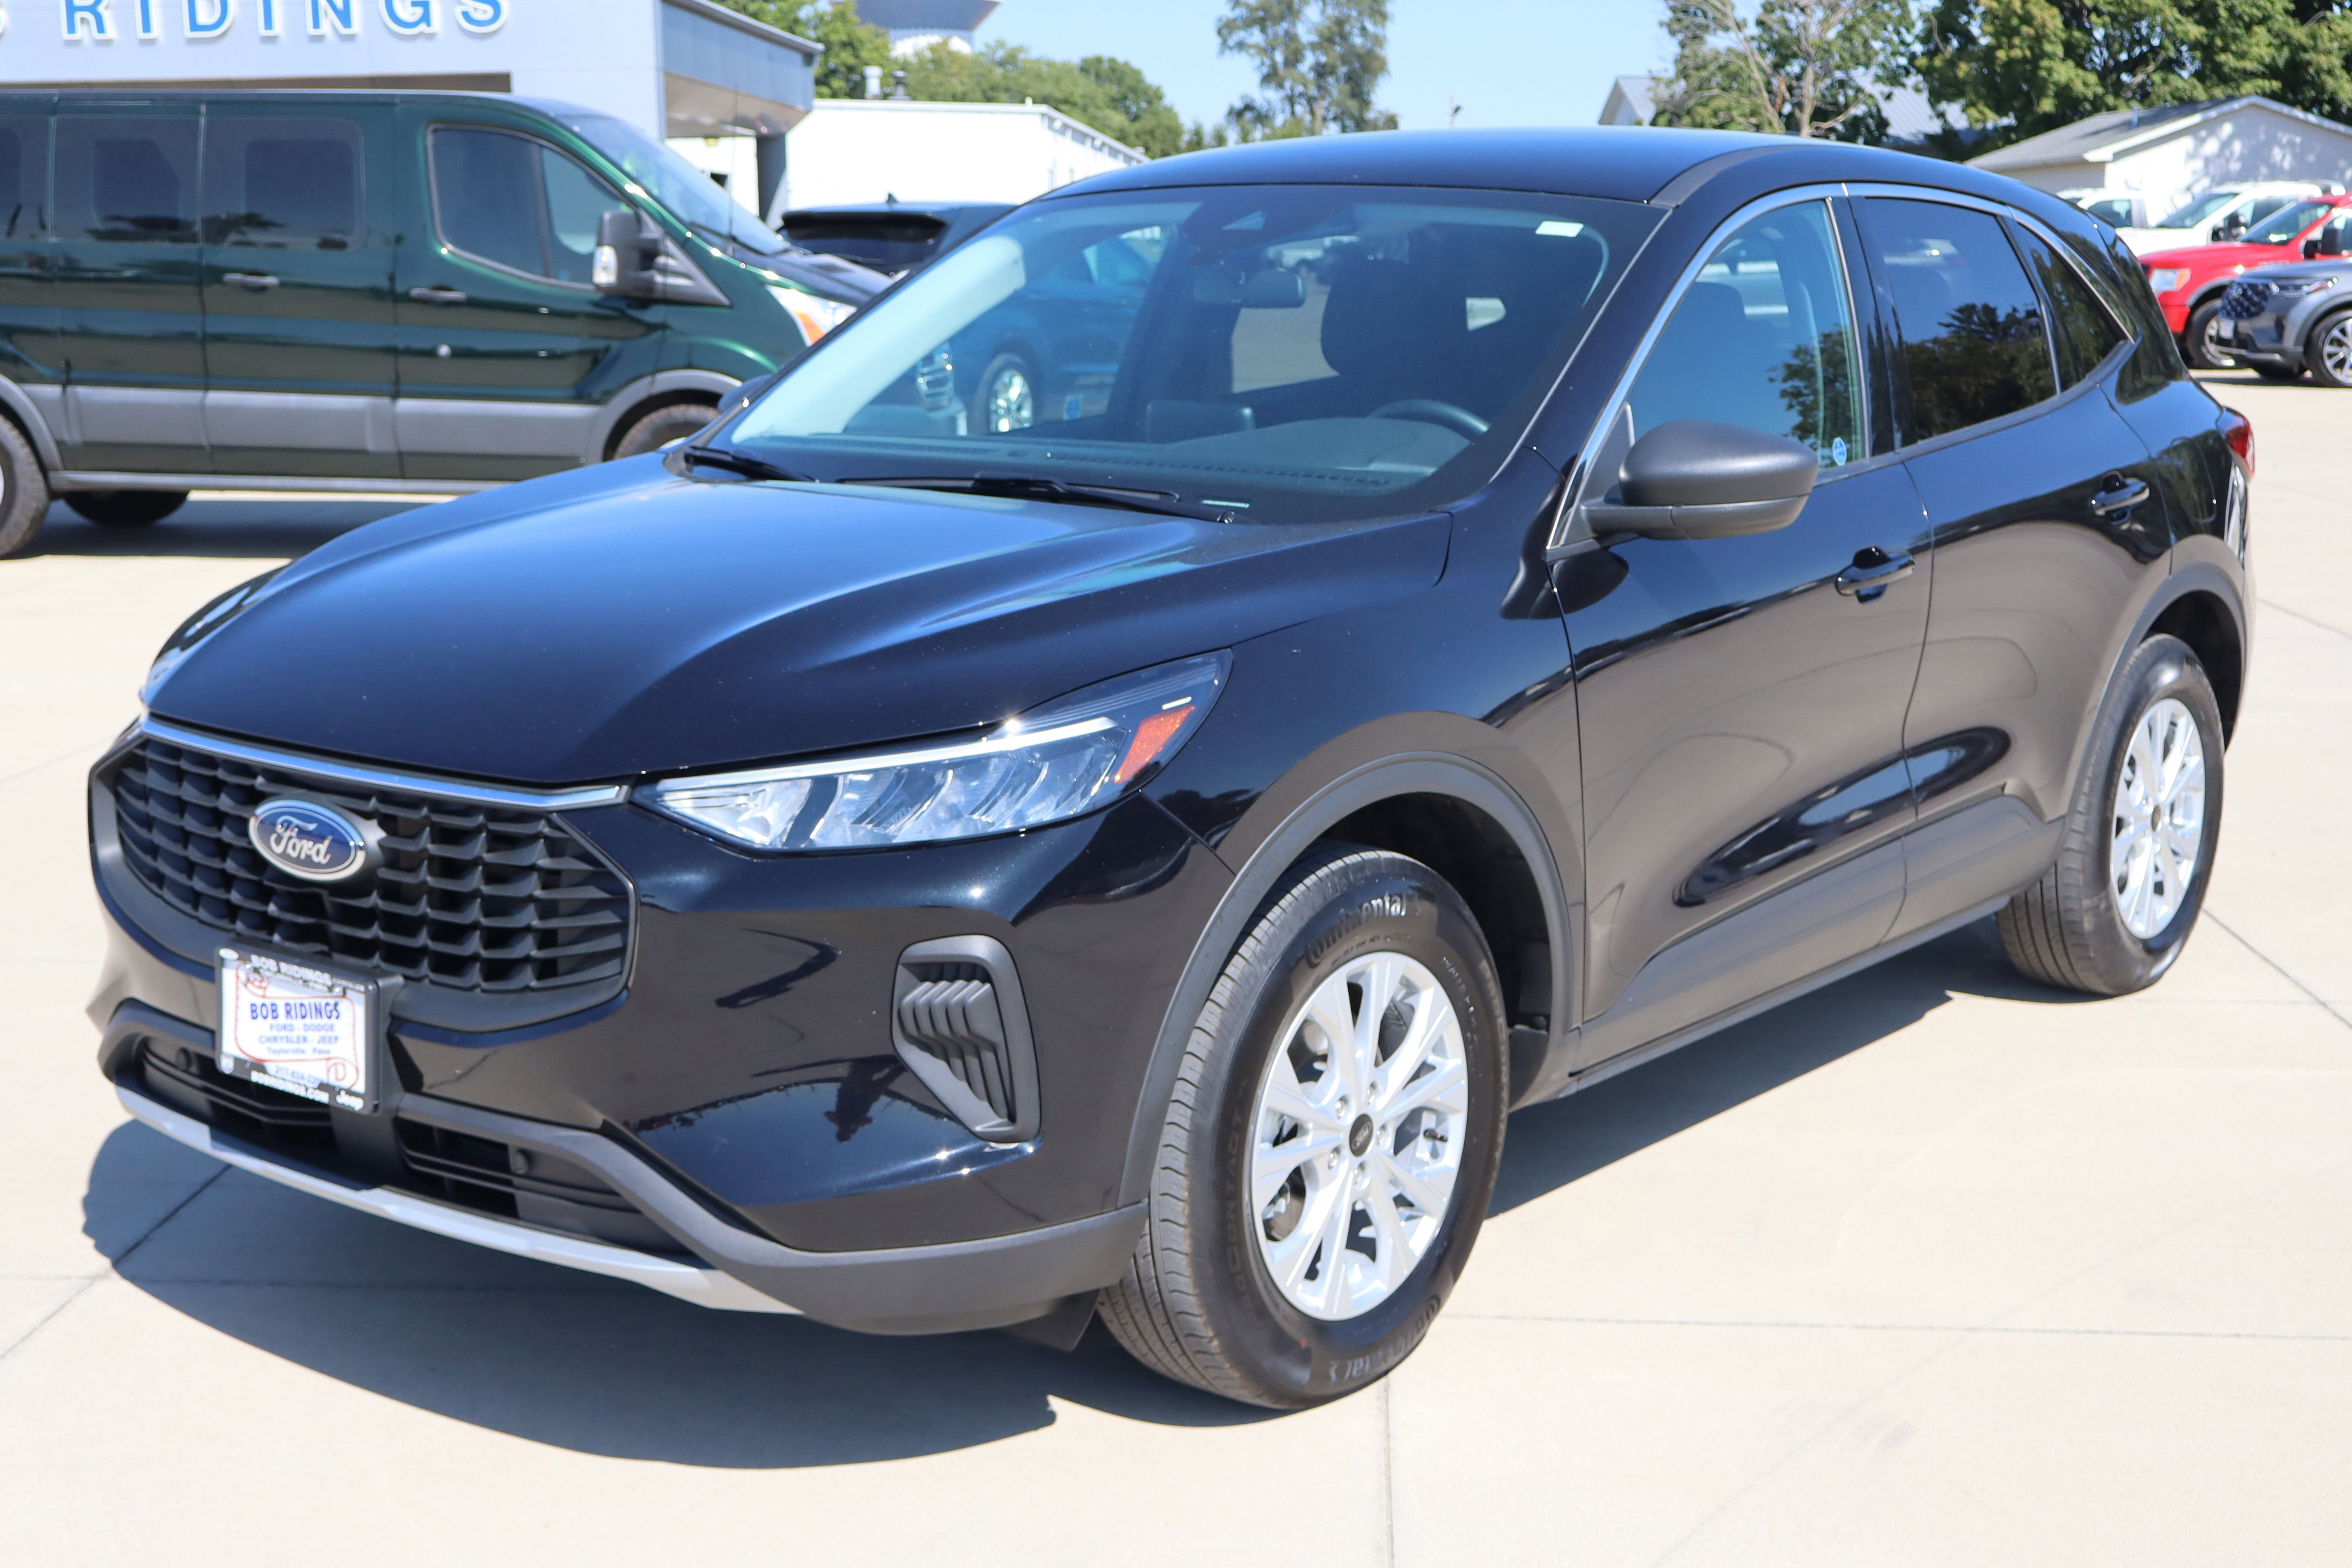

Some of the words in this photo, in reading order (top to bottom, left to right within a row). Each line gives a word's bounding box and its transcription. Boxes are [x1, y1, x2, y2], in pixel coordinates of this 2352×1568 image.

[60, 0, 508, 40] RIDINGS
[270, 815, 333, 865] Ford
[250, 1002, 279, 1020] BOB
[285, 1001, 341, 1020] RIDINGS
[270, 1022, 295, 1032] FORD
[303, 1022, 336, 1033] DODGE
[258, 1034, 309, 1045] CHRYSLER
[316, 1034, 339, 1045] JEEP
